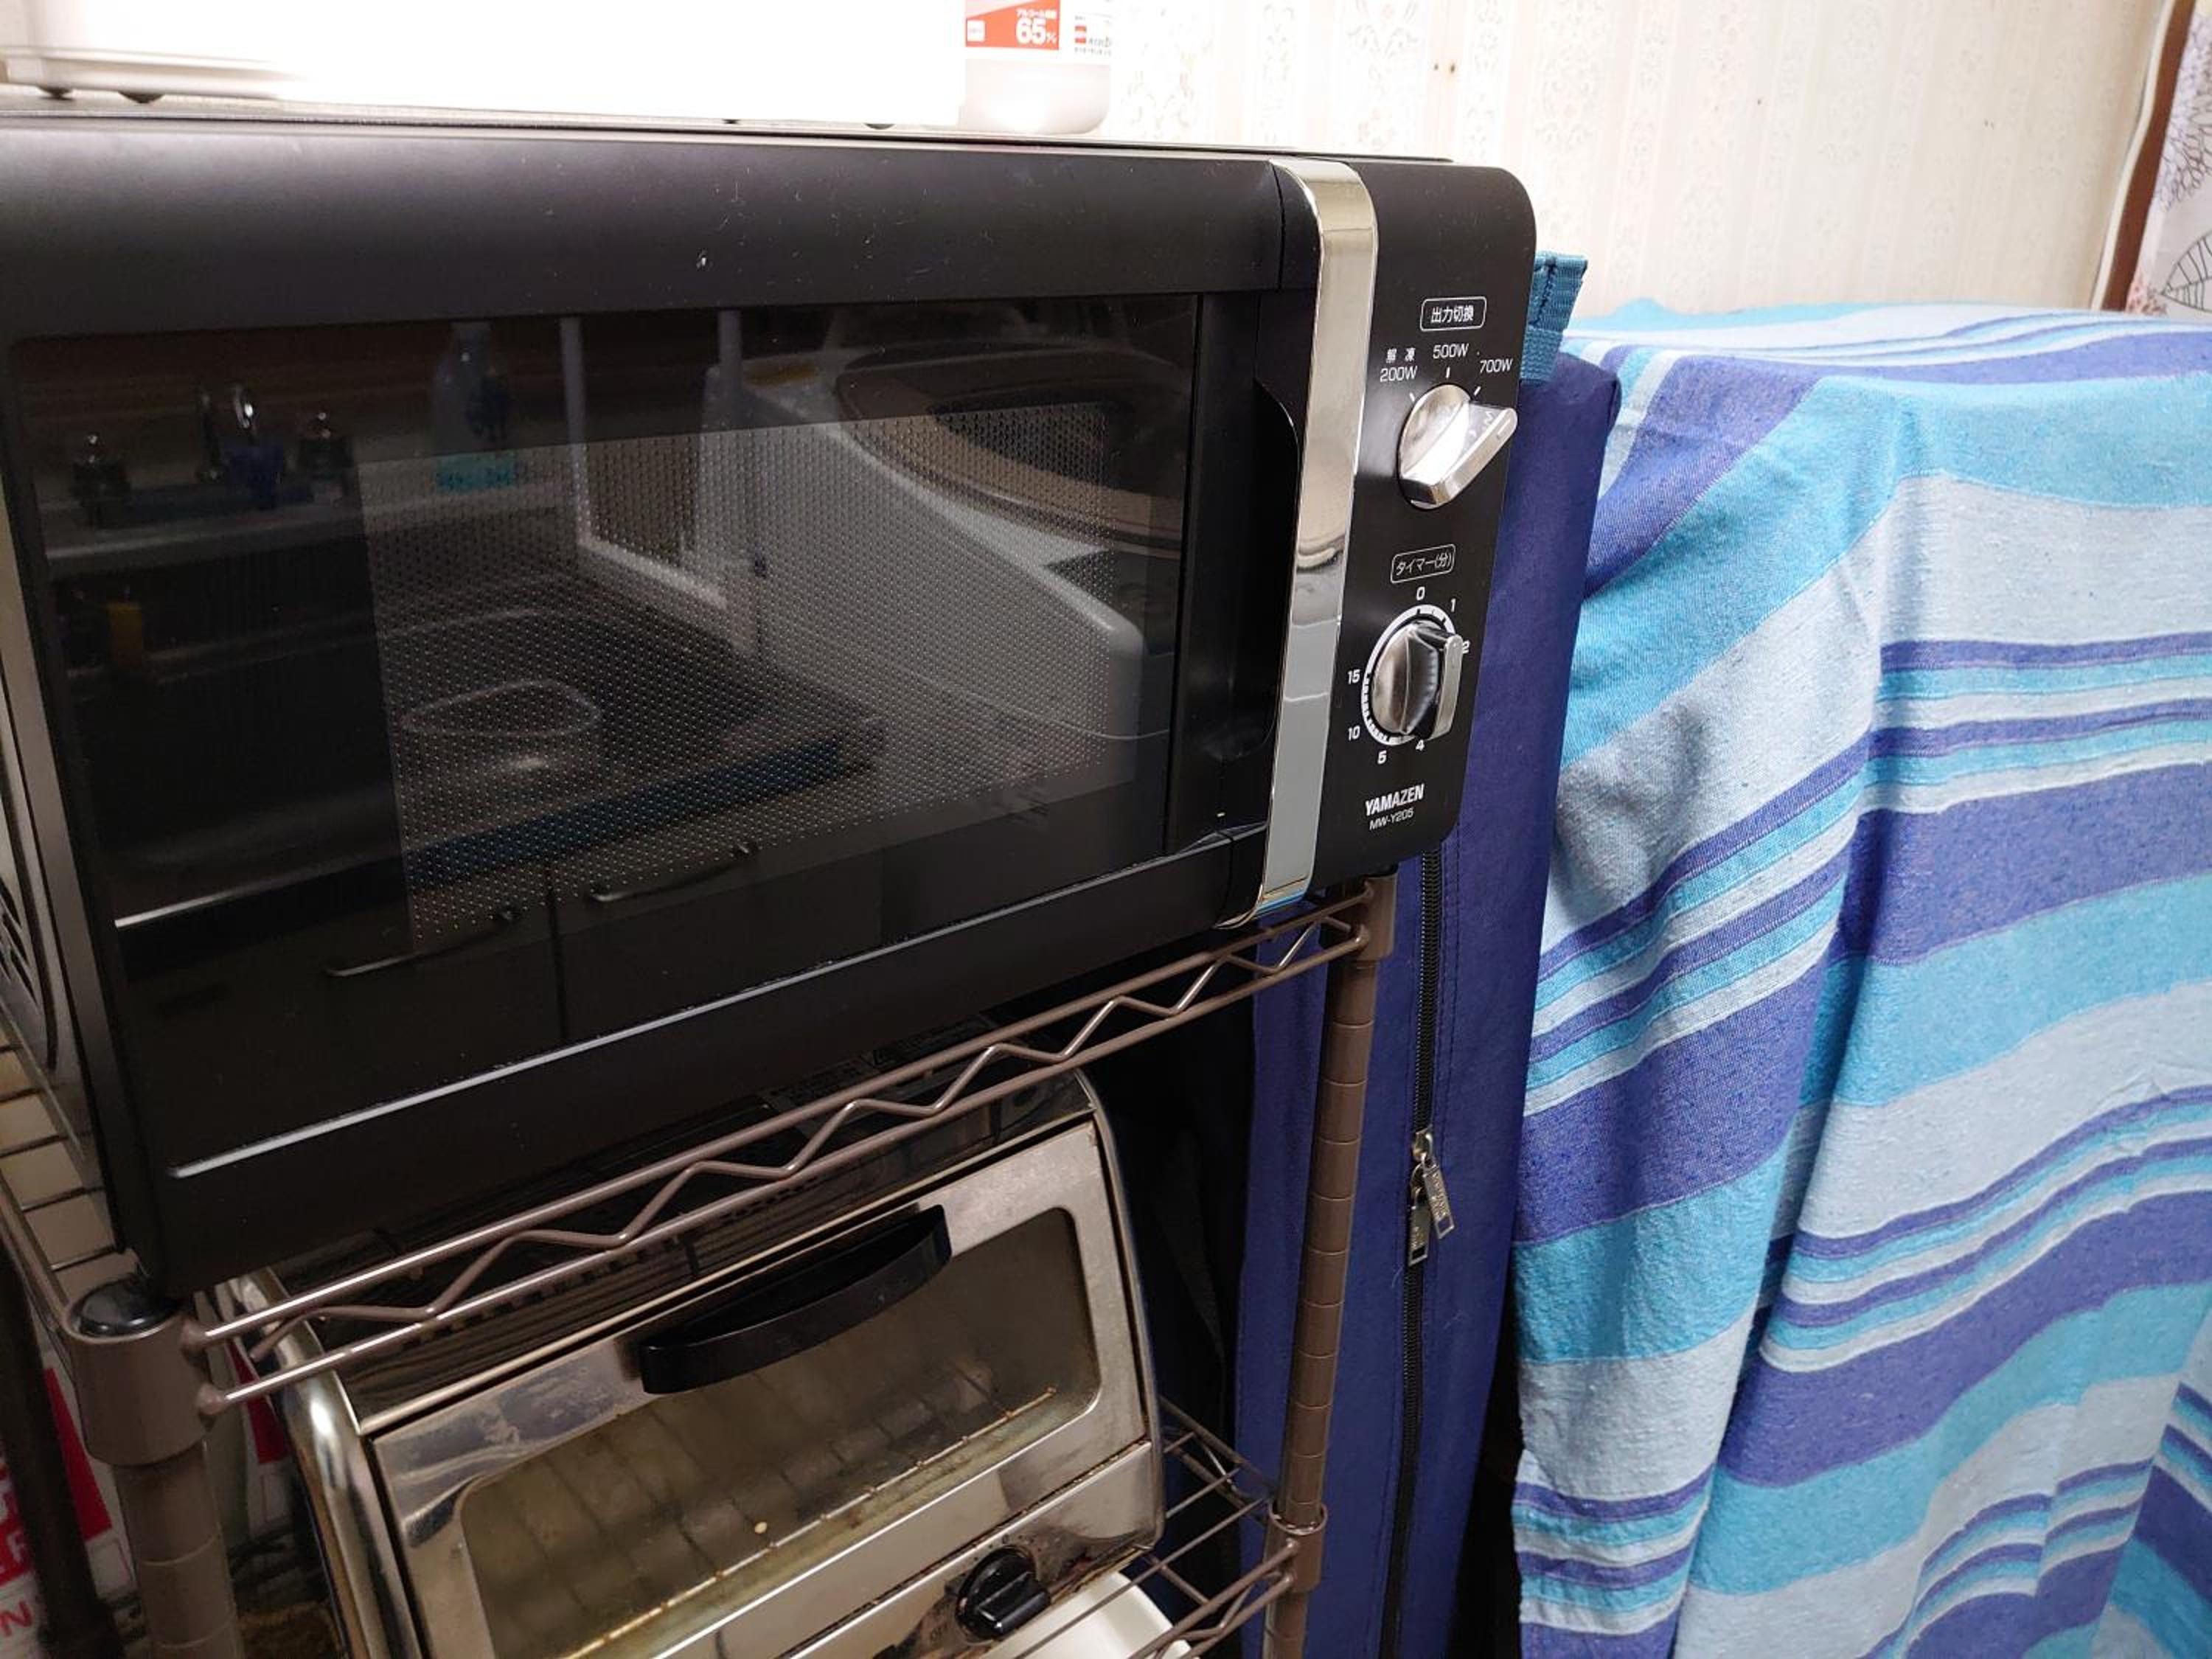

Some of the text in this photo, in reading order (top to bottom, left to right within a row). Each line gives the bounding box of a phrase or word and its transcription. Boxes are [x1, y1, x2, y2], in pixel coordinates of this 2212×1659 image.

[1430, 305, 1474, 323] 出力切換
[1433, 344, 1469, 358] 500W
[1480, 358, 1513, 373] 700W
[1380, 366, 1417, 382] 200W
[1396, 552, 1452, 576] タイマー(分)
[1416, 586, 1425, 601] 0
[1450, 598, 1456, 613] 1
[1347, 669, 1360, 684] 15
[1348, 725, 1360, 741] 10
[1416, 740, 1425, 751] 4
[1377, 751, 1387, 765] 5
[1366, 783, 1425, 816] YAMAZEN
